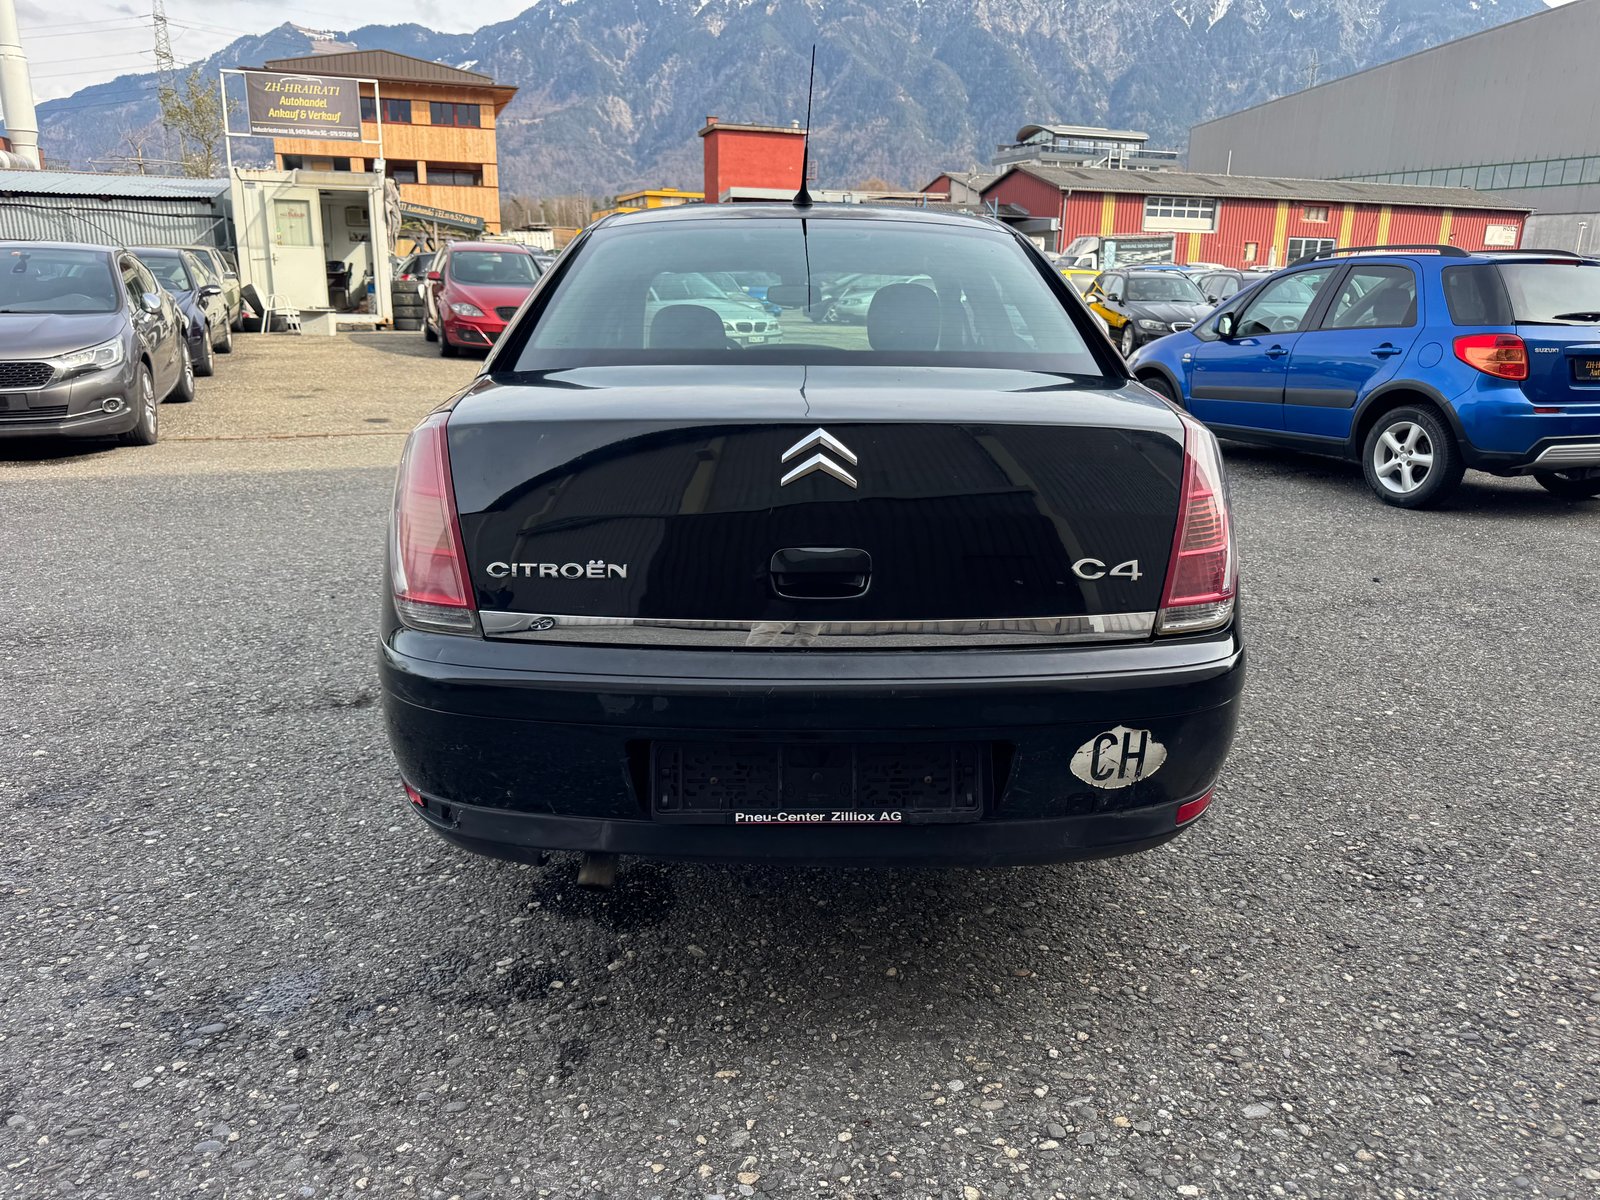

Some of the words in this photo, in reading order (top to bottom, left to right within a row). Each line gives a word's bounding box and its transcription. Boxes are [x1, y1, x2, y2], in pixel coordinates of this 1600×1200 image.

[264, 82, 340, 96] ZH-HRAIRATI
[279, 96, 328, 108] Autohandel
[268, 108, 300, 121] Ankauf
[300, 110, 307, 119] &
[307, 110, 342, 123] Verkauf
[486, 560, 628, 579] CITROËN
[1071, 558, 1143, 581] C4
[1090, 731, 1148, 781] CH
[735, 812, 825, 822] Pneu-Center
[831, 811, 875, 822] Zilliox
[879, 811, 902, 821] AG
